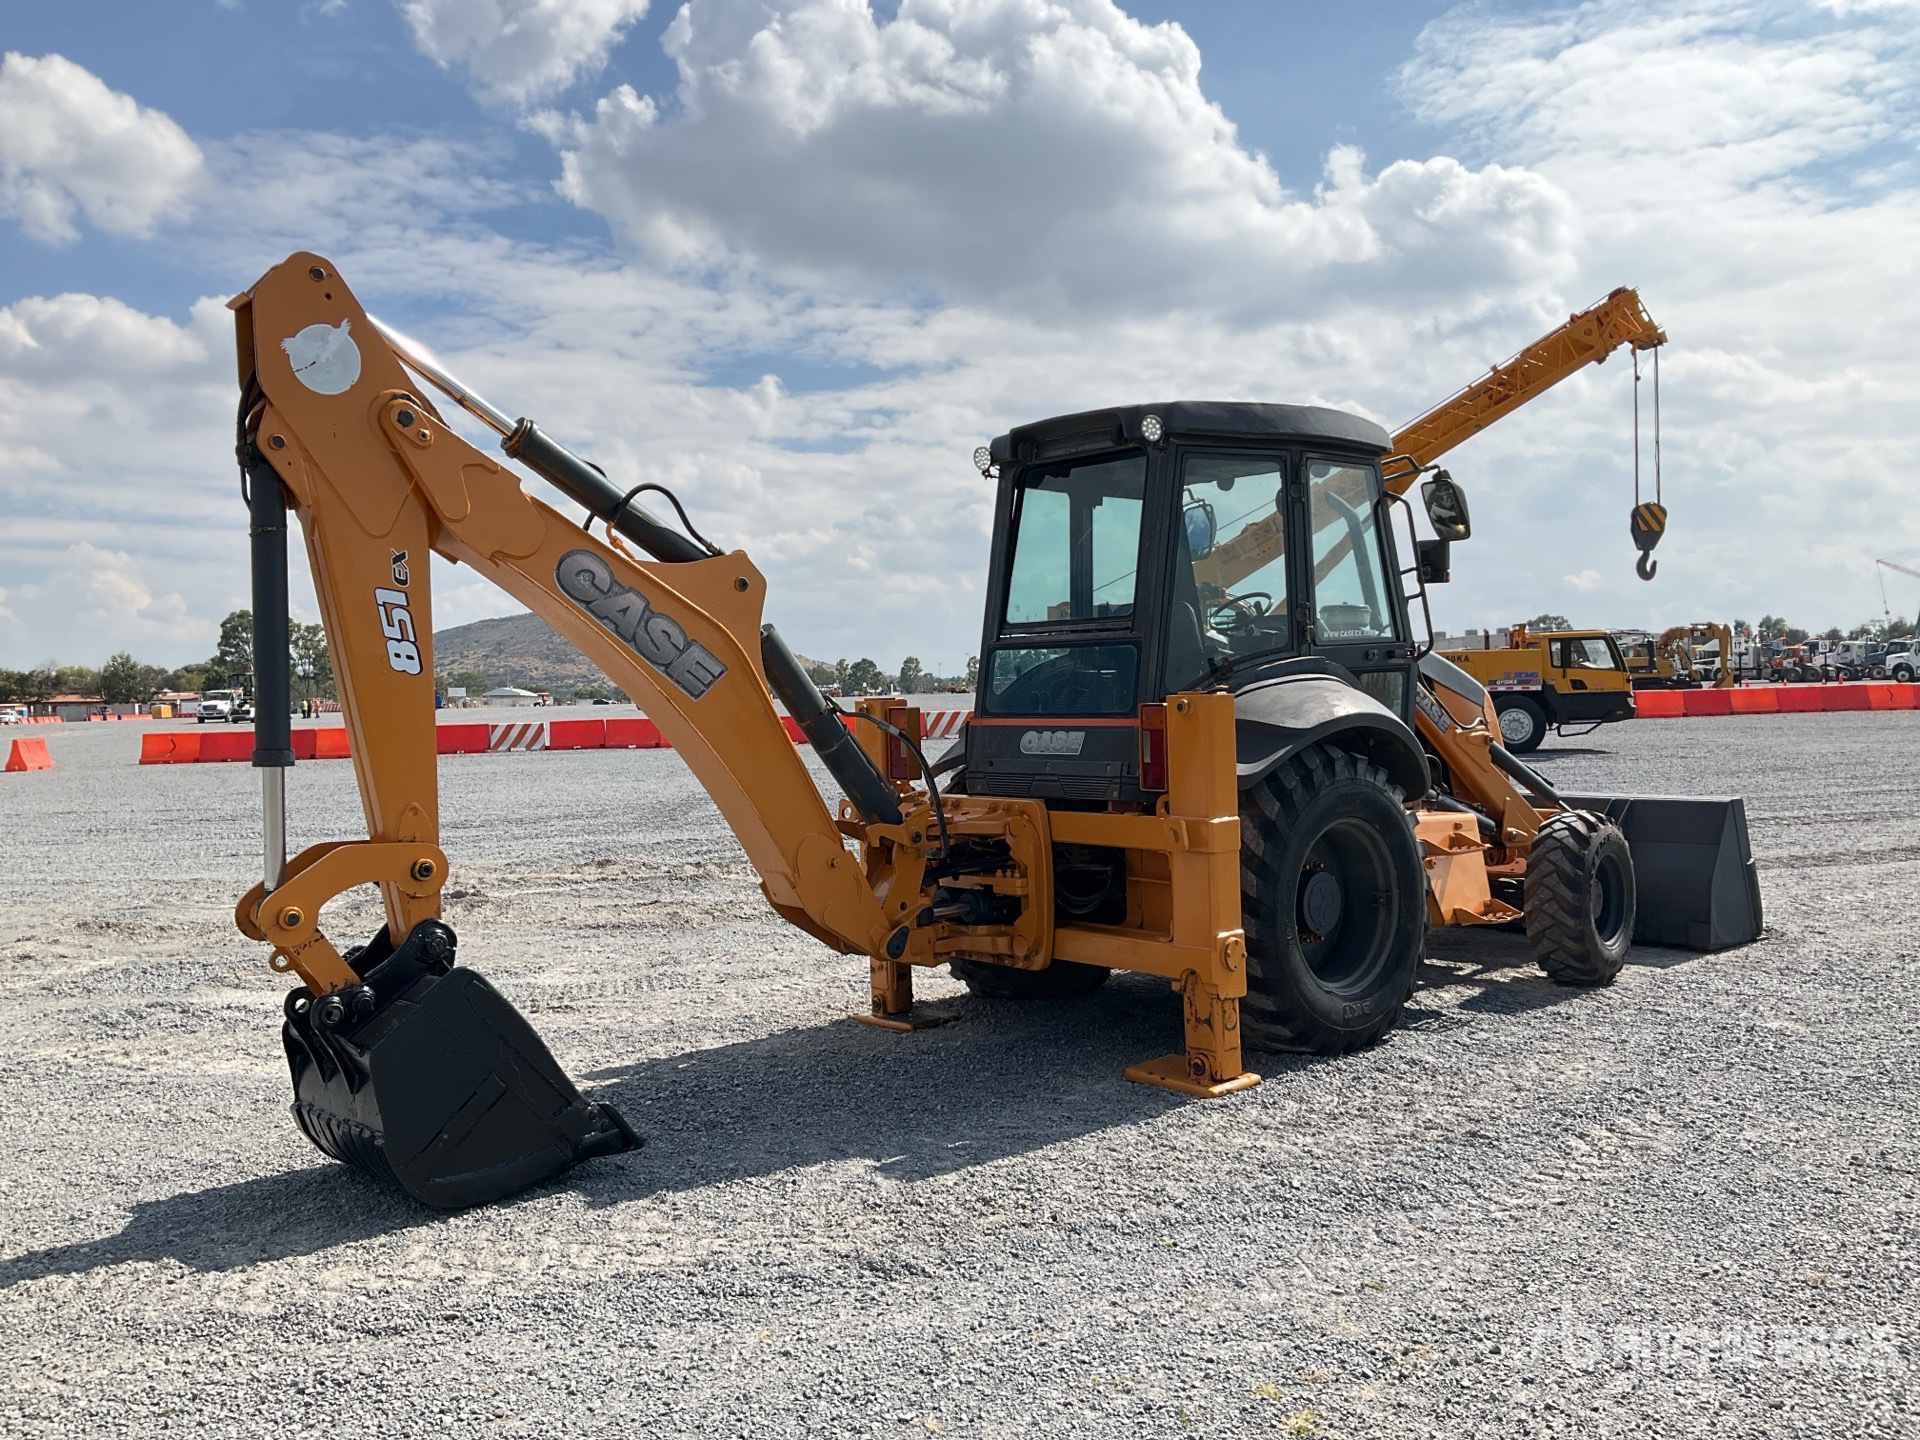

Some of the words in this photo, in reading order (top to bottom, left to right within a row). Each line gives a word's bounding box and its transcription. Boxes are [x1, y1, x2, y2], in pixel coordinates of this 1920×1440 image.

[390, 548, 409, 587] EX
[375, 587, 422, 675] 851
[555, 549, 727, 700] CASE
[1442, 655, 1470, 663] 50KA
[1020, 731, 1085, 754] CASE
